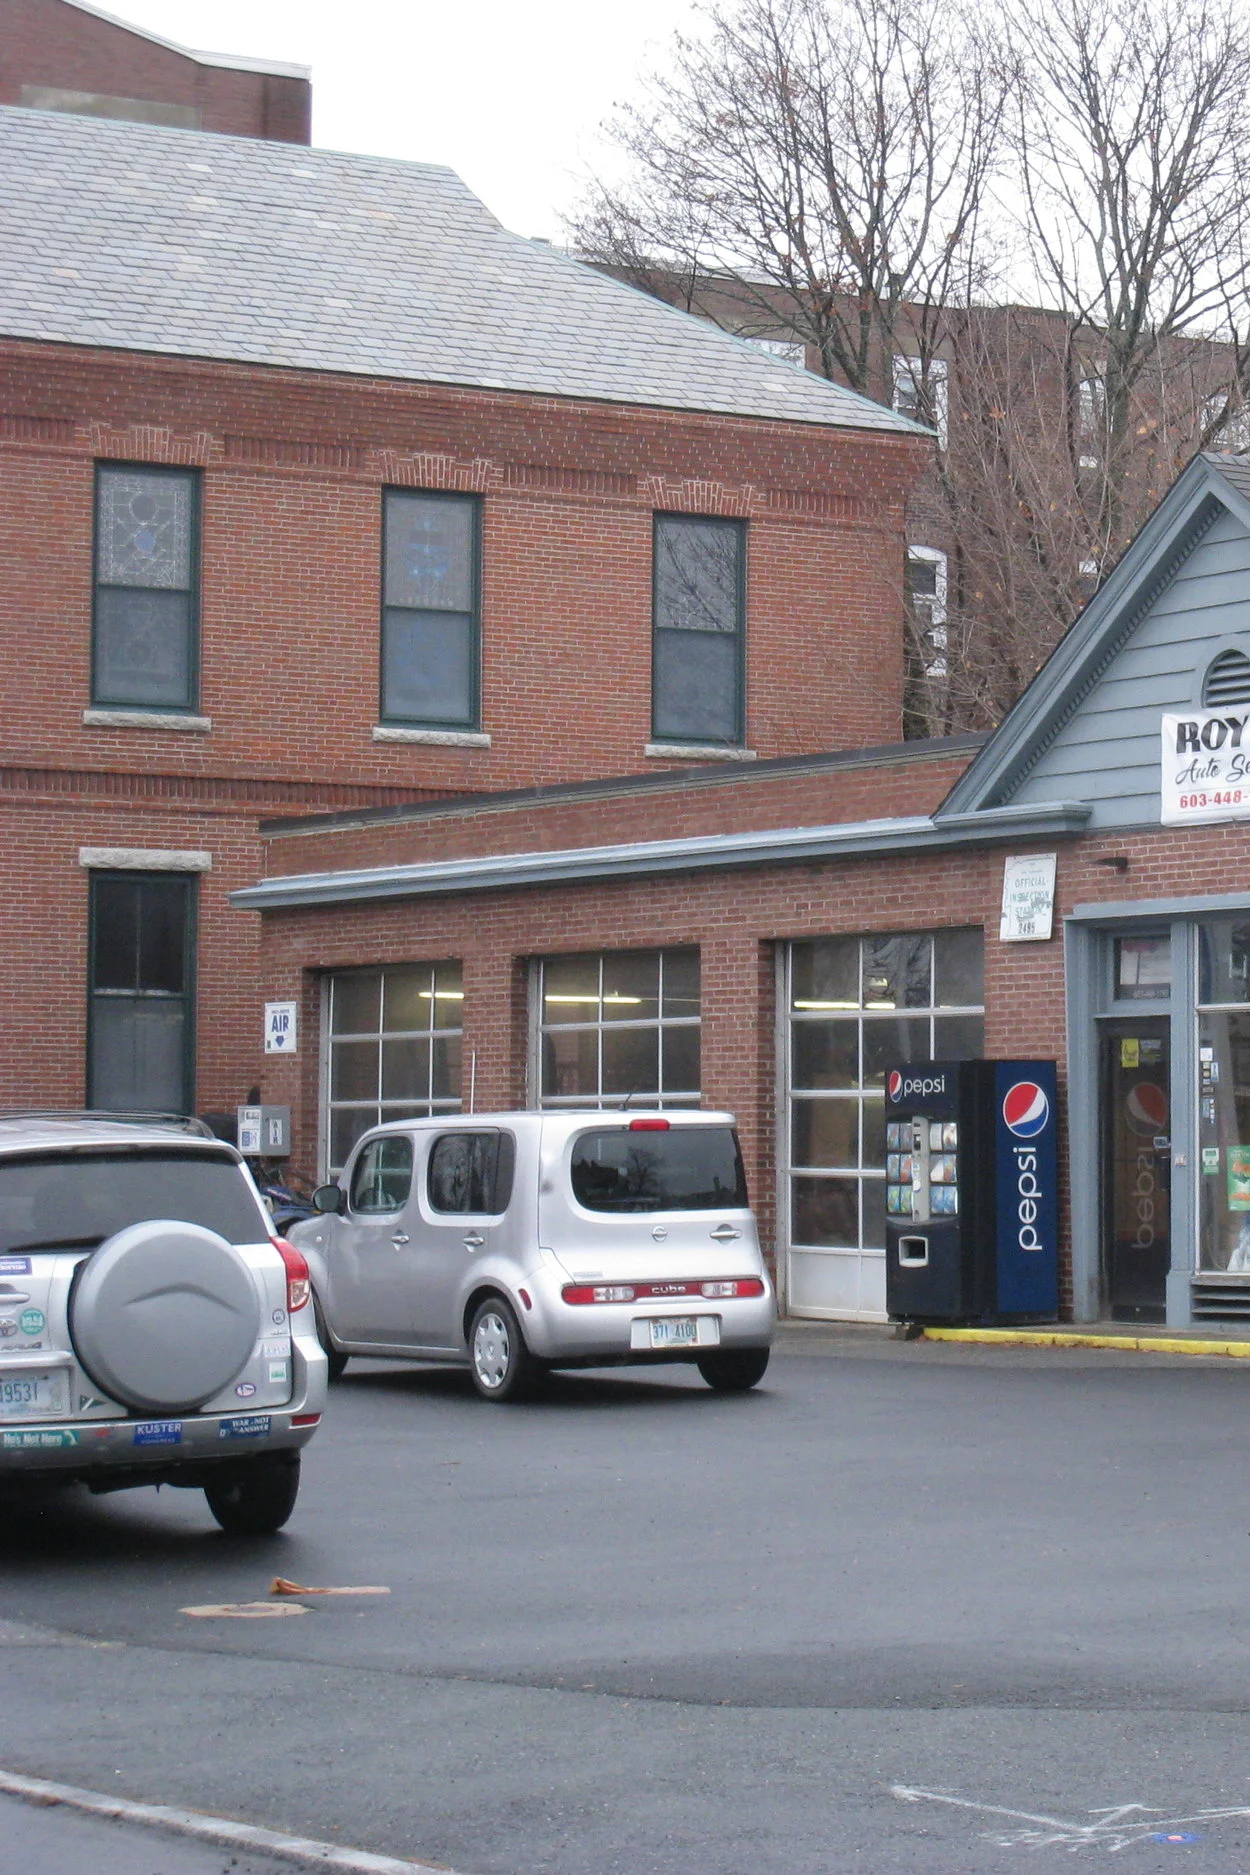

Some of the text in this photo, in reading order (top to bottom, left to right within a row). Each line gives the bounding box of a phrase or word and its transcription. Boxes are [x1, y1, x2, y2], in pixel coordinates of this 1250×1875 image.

[1175, 757, 1221, 785] Auto
[1014, 877, 1046, 888] OFFICIAL
[271, 1014, 289, 1032] AIR
[903, 1075, 945, 1097] pepsi
[1013, 1146, 1043, 1251] pepsi
[651, 1285, 687, 1294] cube
[653, 1324, 668, 1339] 371
[0, 1382, 38, 1403] 9531
[137, 1422, 182, 1434] KUSTER
